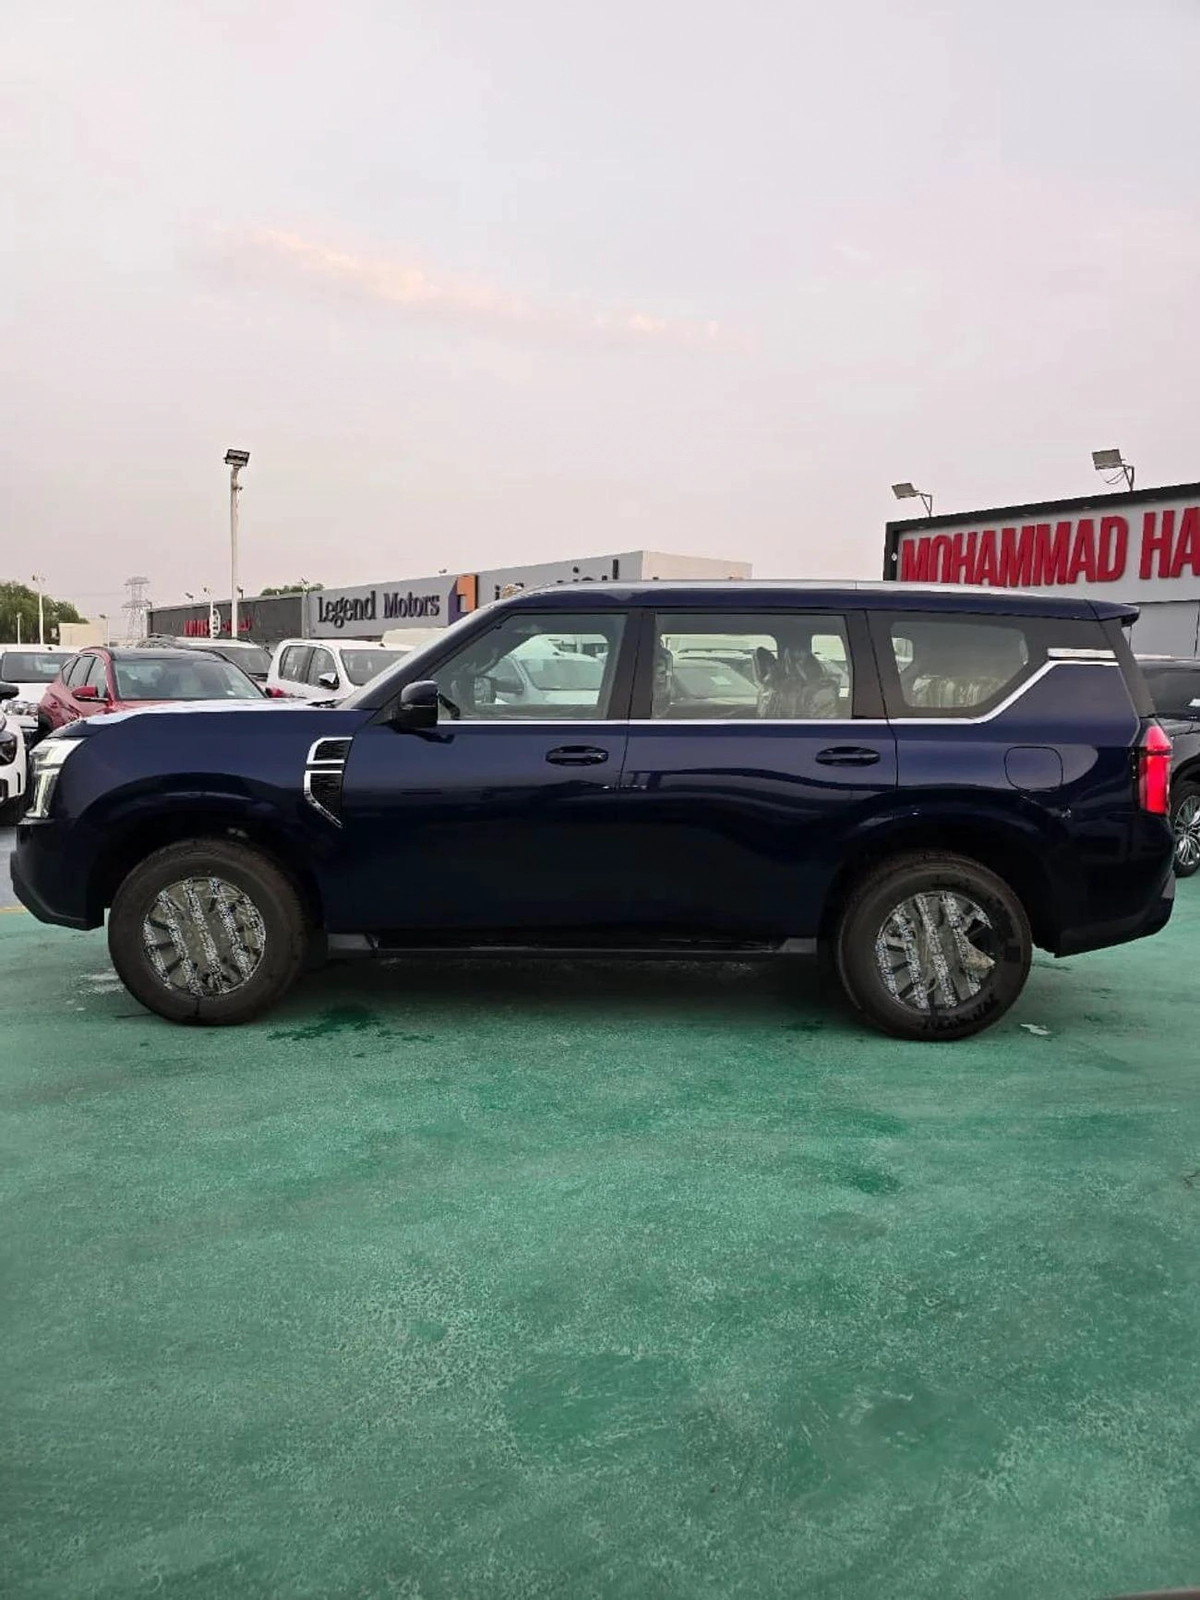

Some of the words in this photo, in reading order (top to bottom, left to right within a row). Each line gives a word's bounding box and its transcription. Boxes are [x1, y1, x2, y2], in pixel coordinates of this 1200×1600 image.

[901, 515, 1128, 588] MOHAMMAD
[317, 590, 377, 628] Legend
[383, 591, 440, 619] Motors
